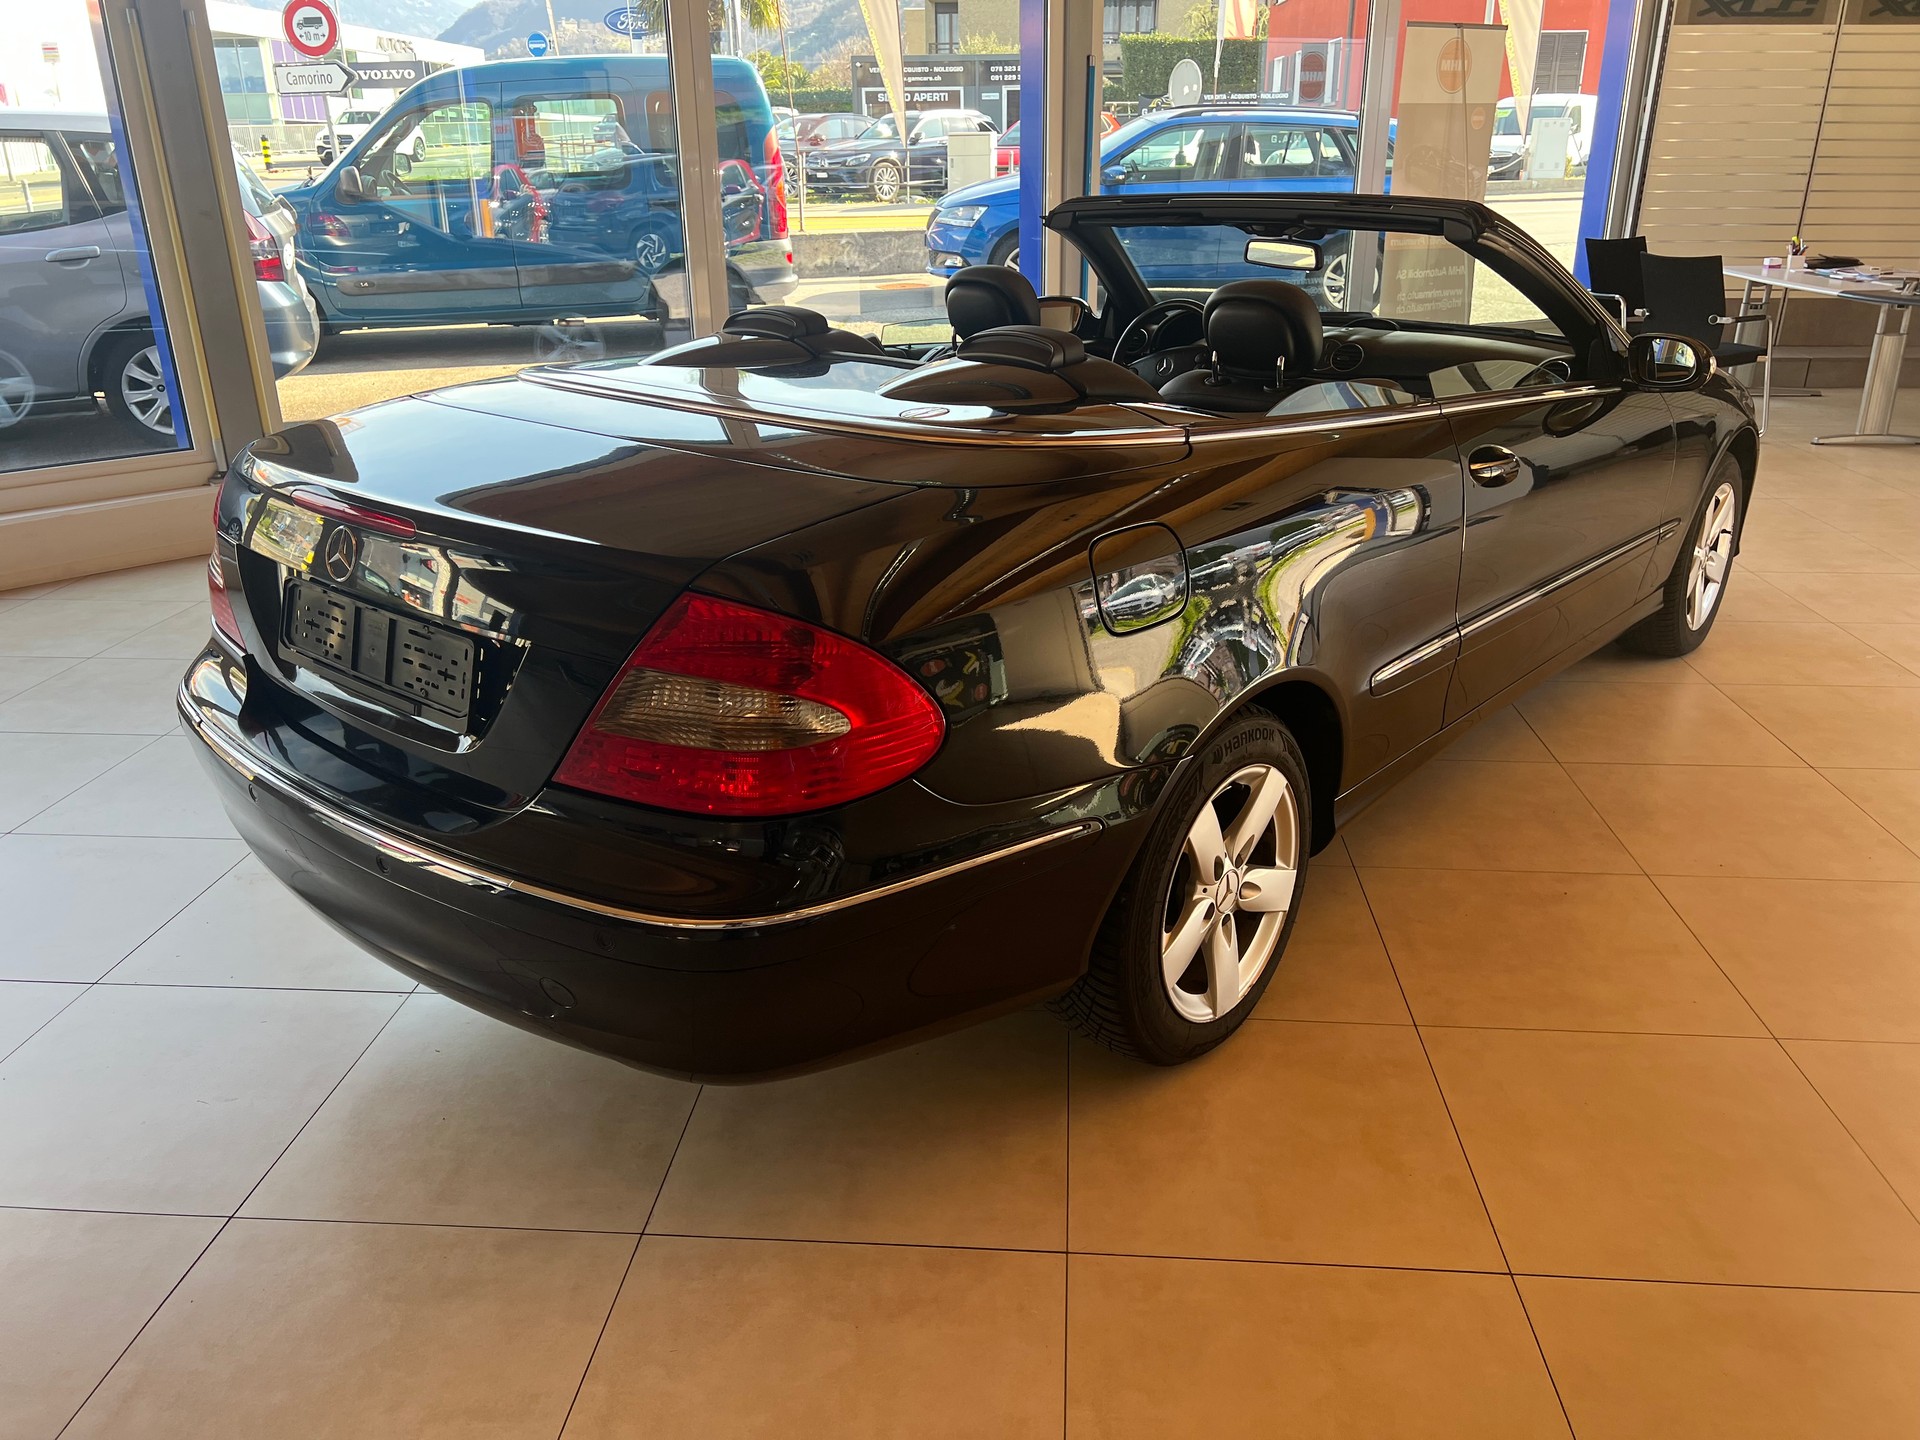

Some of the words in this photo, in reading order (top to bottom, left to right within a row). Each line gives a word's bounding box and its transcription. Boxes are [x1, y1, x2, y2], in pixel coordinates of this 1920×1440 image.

[304, 31, 312, 41] 10
[313, 32, 321, 41] m
[286, 70, 333, 86] Camorino
[356, 69, 416, 80] VOLVO
[913, 92, 949, 102] APERTI
